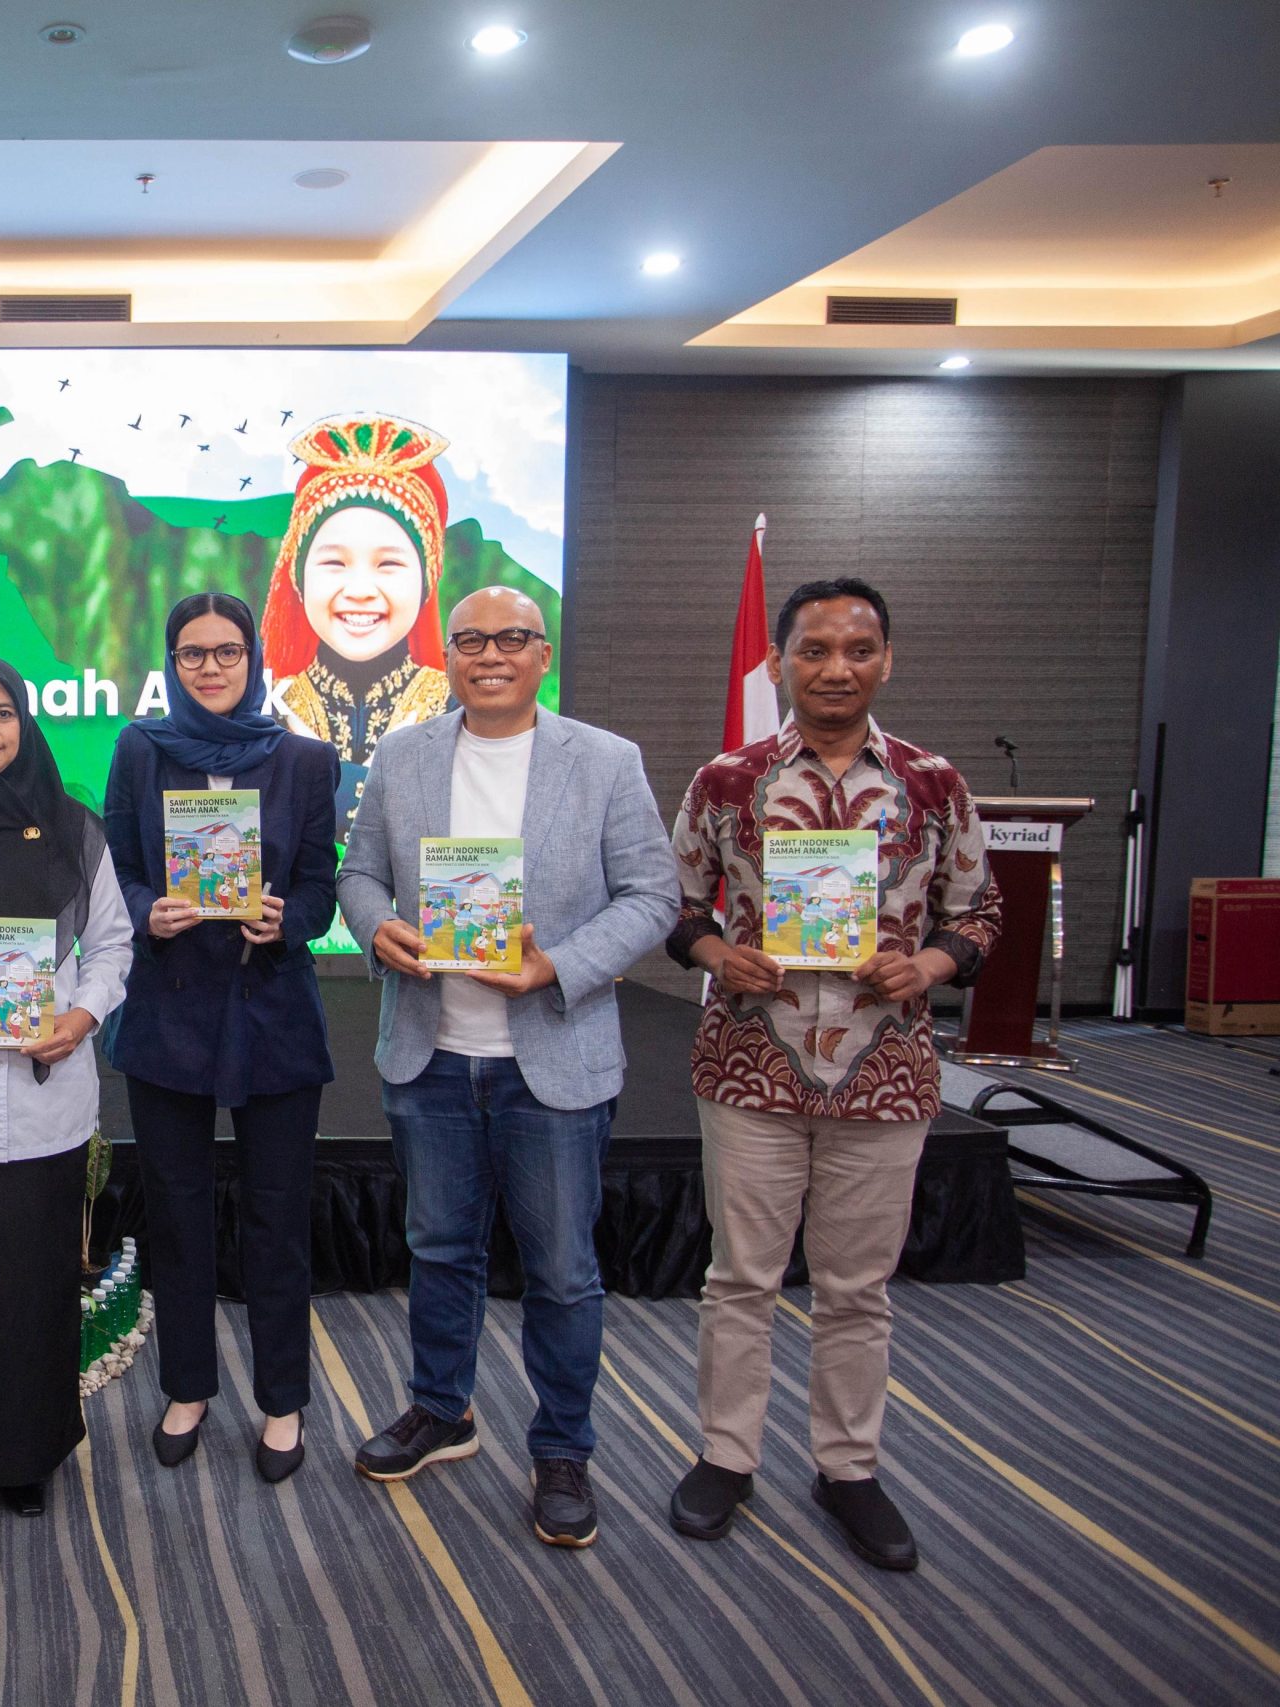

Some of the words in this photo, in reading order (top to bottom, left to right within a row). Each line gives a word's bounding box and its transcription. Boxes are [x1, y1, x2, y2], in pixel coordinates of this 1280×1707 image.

[134, 668, 296, 717] Ak
[170, 799, 193, 807] SAWIT
[194, 798, 238, 806] INDONESIA
[170, 806, 197, 814] RAMAH
[198, 806, 220, 814] ANAK
[990, 828, 1050, 845] Kyriad
[769, 839, 797, 847] SAWIT
[799, 839, 850, 847] INDONESIA
[425, 846, 451, 854] SAWIT
[453, 846, 499, 854] INDONESIA
[769, 847, 801, 855] RAMAH
[803, 847, 828, 855] ANAK
[425, 854, 454, 862] RAMAH
[456, 854, 479, 862] ANAK
